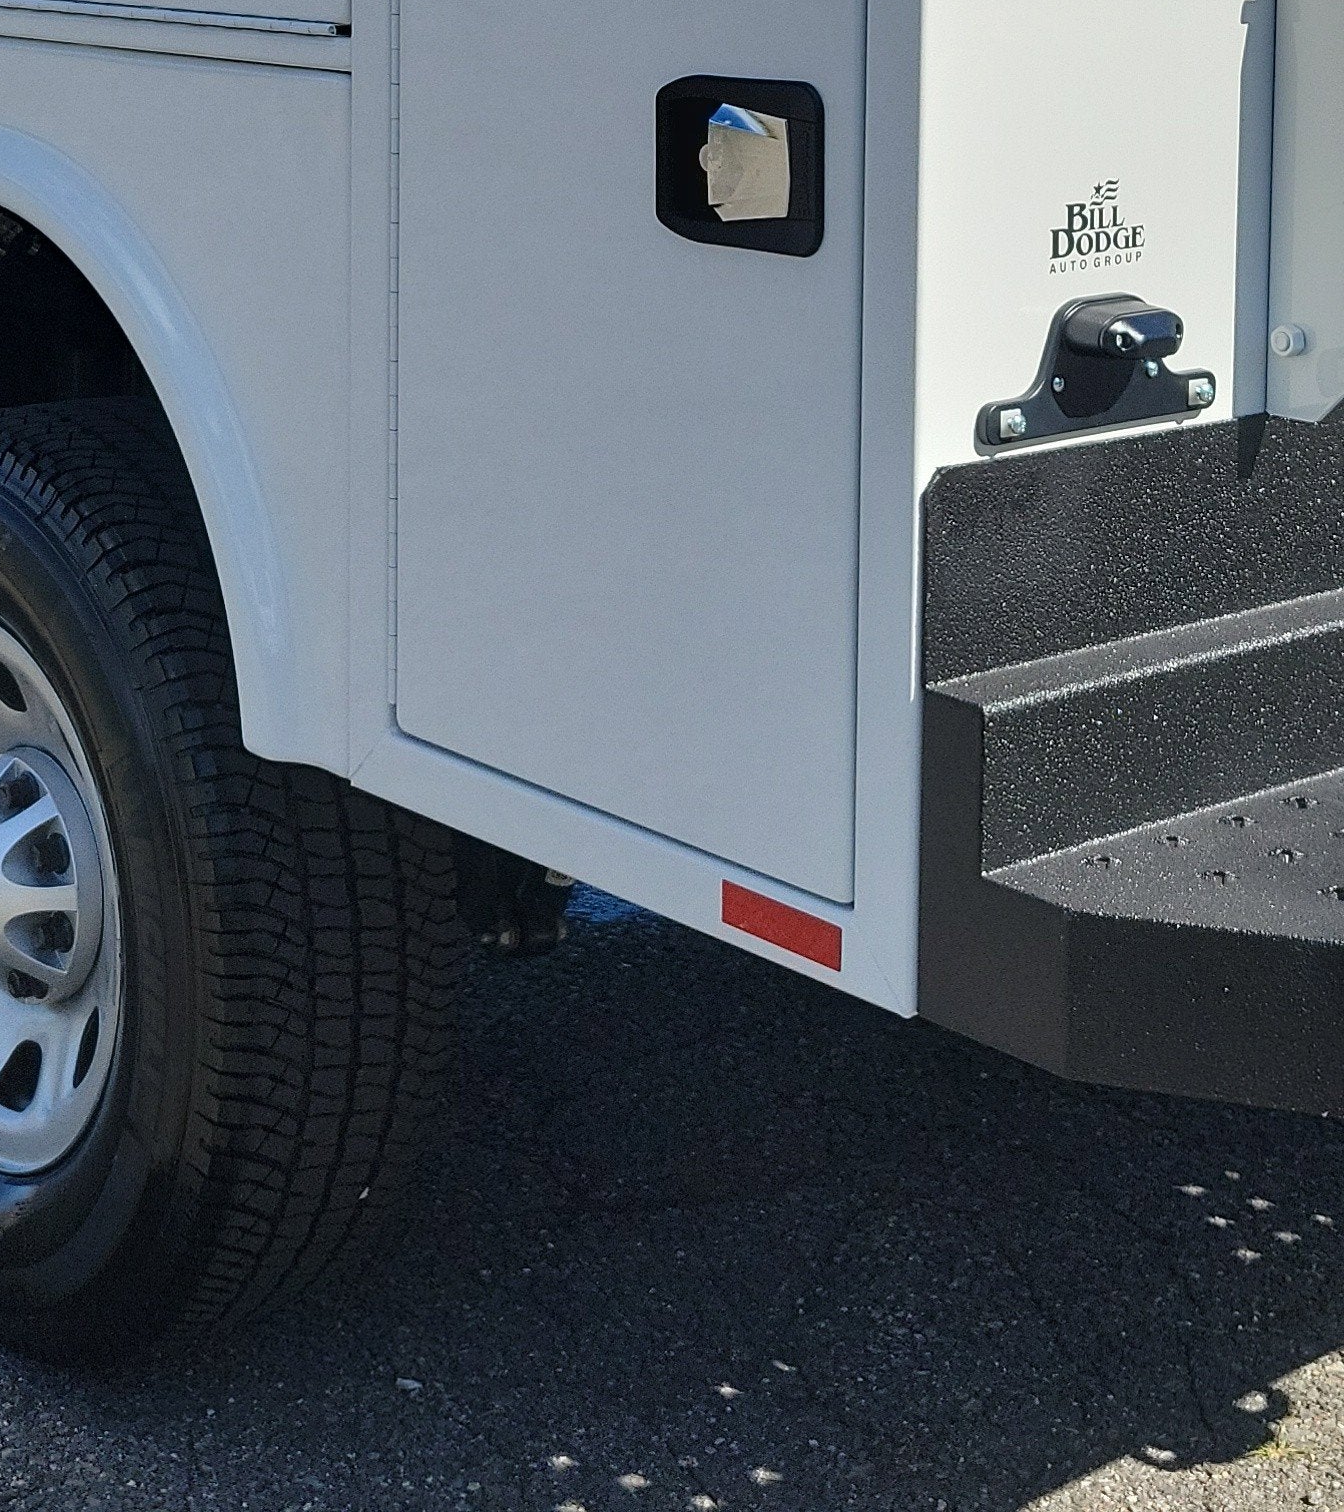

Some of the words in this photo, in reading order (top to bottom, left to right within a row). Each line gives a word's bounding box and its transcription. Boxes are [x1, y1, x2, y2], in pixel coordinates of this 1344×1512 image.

[1065, 202, 1125, 233] BILL
[1049, 224, 1146, 260] DODGE
[1049, 259, 1088, 275] AUTO
[1093, 251, 1143, 268] GROUP
